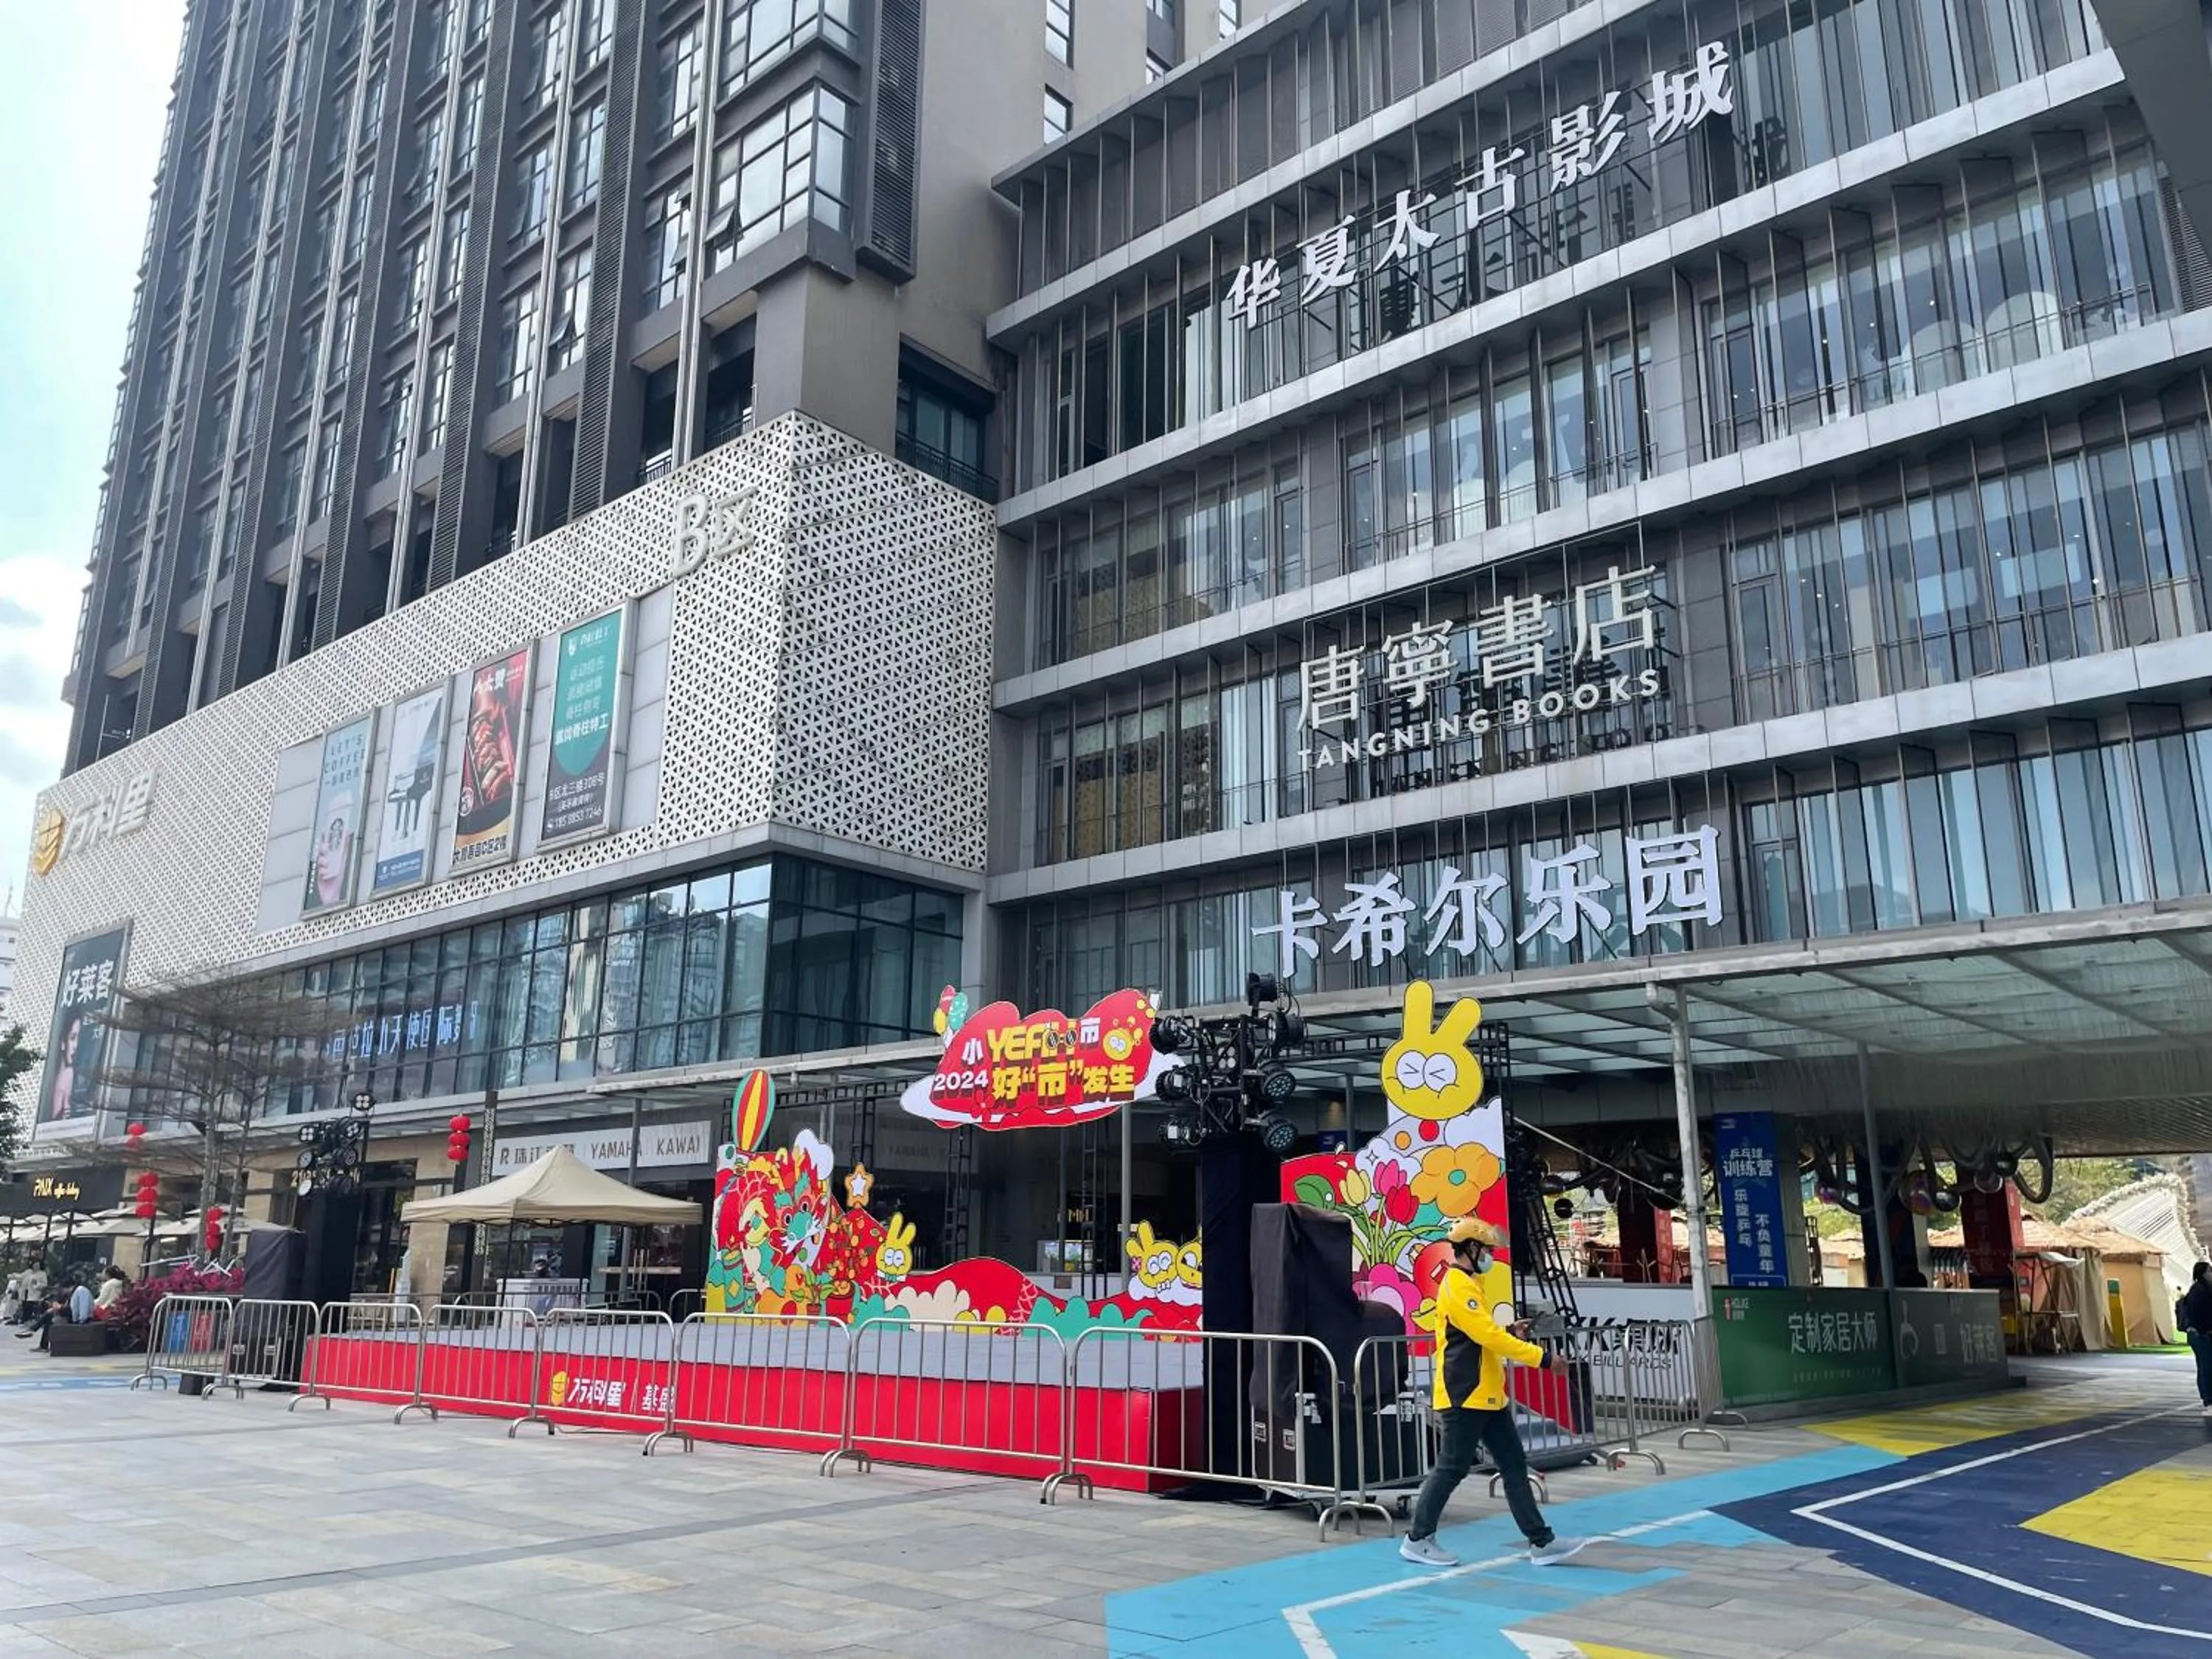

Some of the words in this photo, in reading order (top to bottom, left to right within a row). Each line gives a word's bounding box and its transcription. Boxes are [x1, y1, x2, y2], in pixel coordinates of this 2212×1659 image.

[1227, 41, 1733, 329] 华夏太古影城
[672, 486, 758, 578] B区
[1298, 566, 1656, 732] 唐寧書店
[1298, 708, 1491, 771] TANGNING
[1513, 669, 1660, 724] BOOKS
[1251, 824, 1723, 978] 卡希尔乐园
[60, 959, 114, 1007] 好莱客
[933, 1069, 990, 1091] 2024
[591, 1139, 642, 1160] YAMAHA
[656, 1135, 700, 1155] KAWAI
[1722, 1159, 1773, 1178] 训练营
[1788, 1311, 1877, 1354] 定制家居大师
[568, 1378, 626, 1407] 万科里
